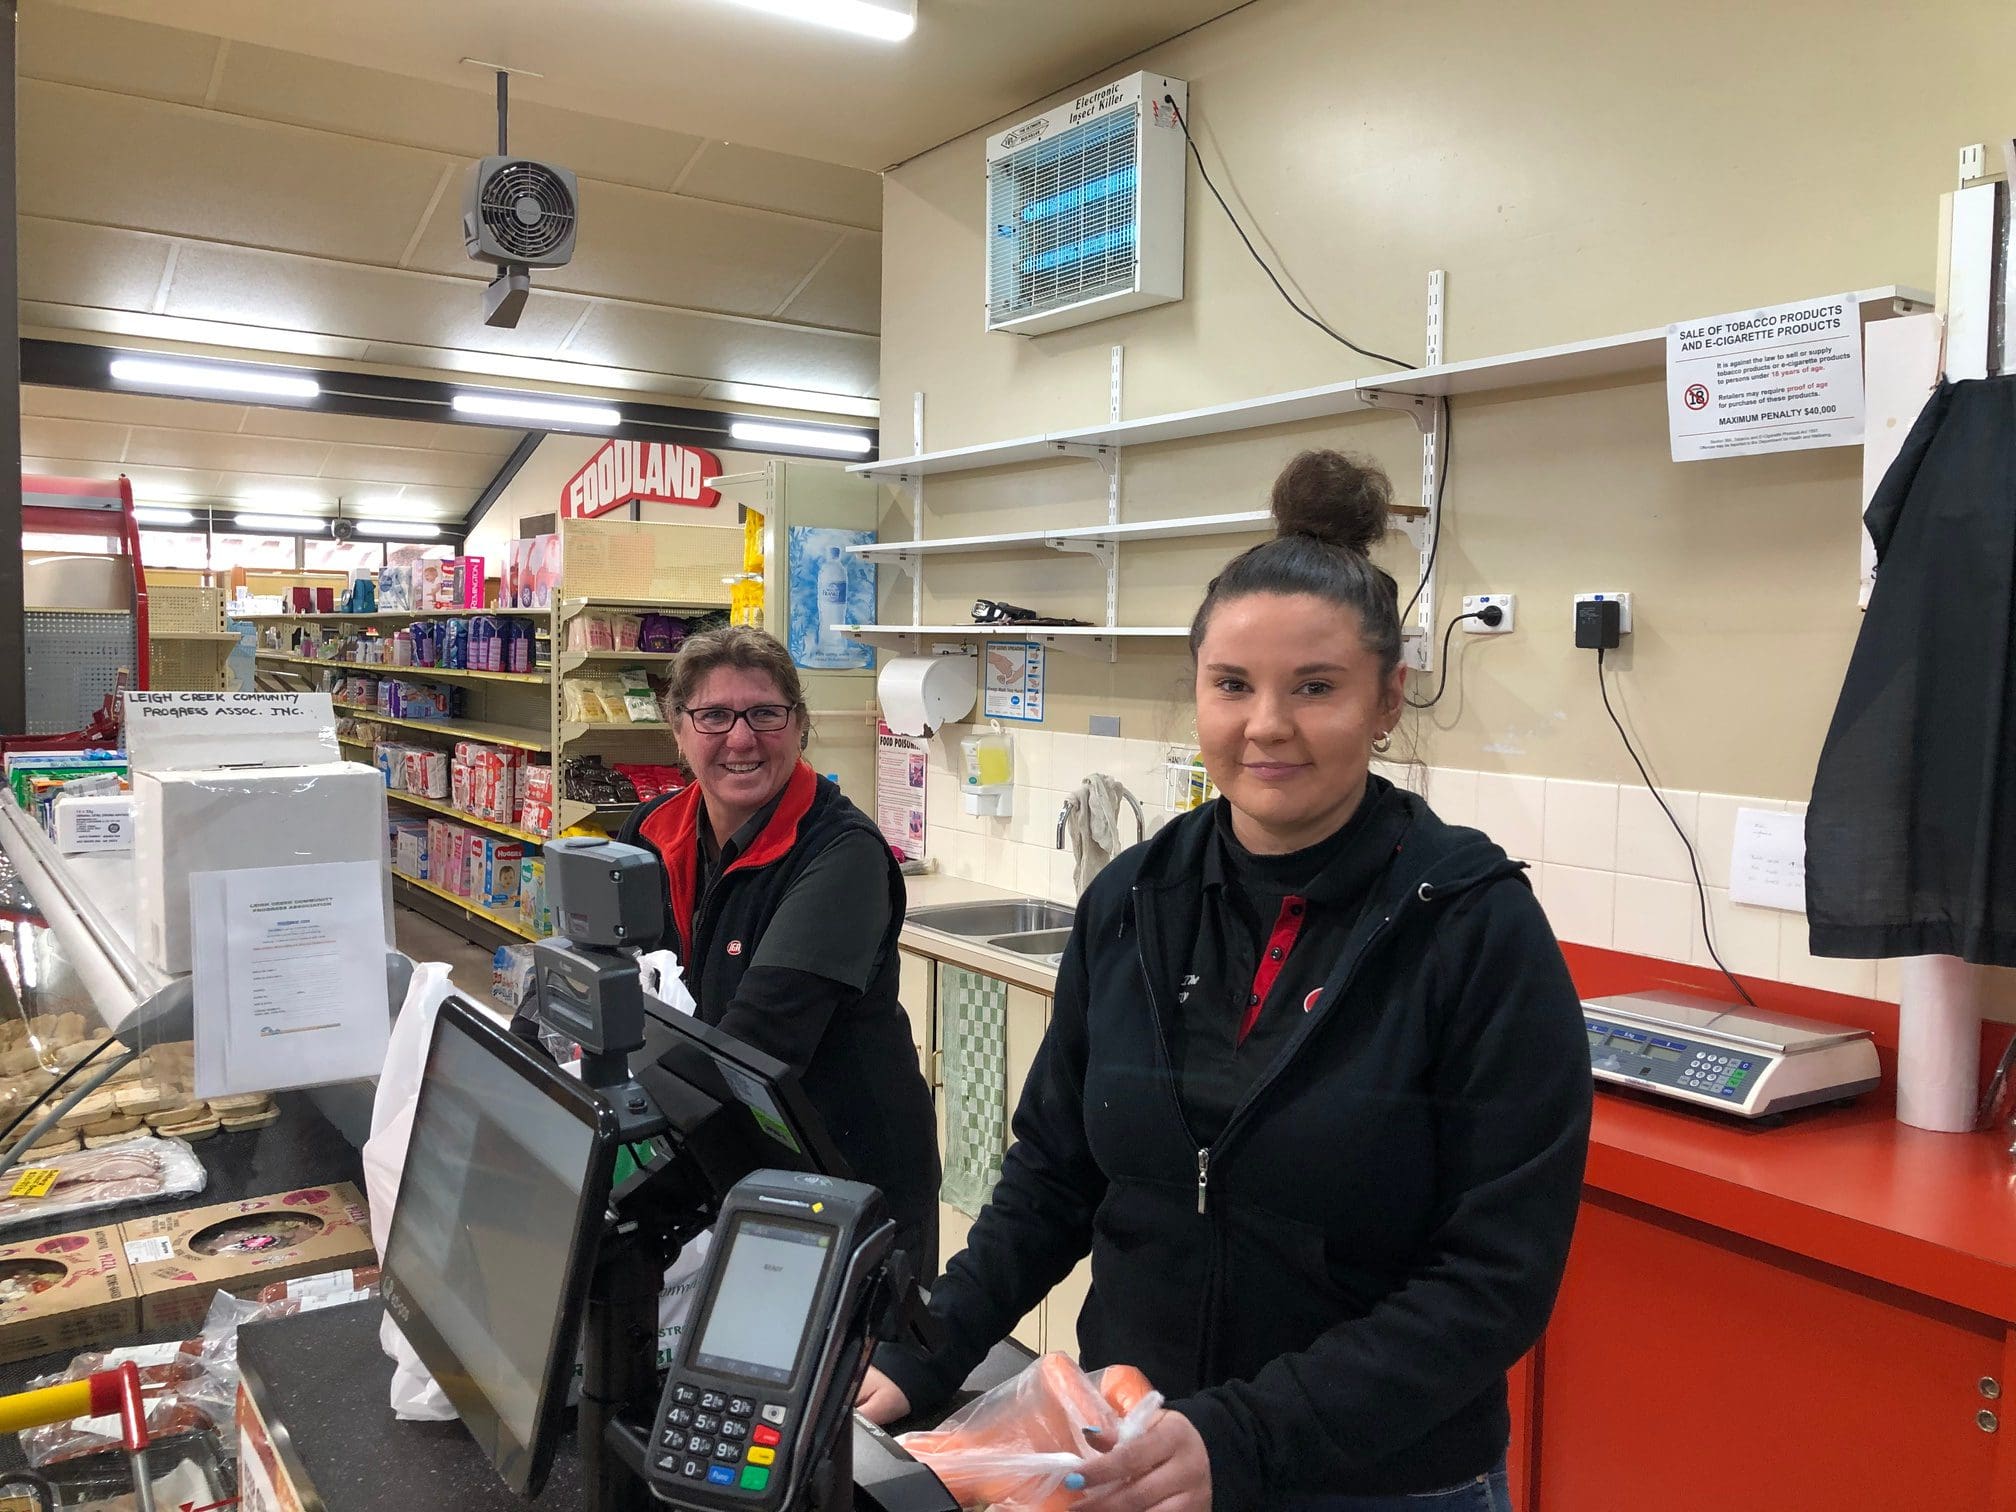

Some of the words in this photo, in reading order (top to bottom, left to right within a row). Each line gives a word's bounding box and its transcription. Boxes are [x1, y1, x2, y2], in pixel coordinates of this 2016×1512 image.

[1075, 83, 1120, 110] Electronic
[1069, 106, 1094, 124] Insect
[1098, 93, 1124, 111] Killer
[1679, 327, 1704, 341] SALE
[1707, 325, 1722, 336] OF
[1726, 316, 1777, 333] TOBACCO
[1780, 305, 1842, 324] PRODUCTS
[1681, 339, 1702, 352] AND
[1705, 329, 1774, 348] E-CIGARETTE
[1777, 318, 1841, 336] PRODUCTS
[1730, 359, 1752, 368] against
[1786, 351, 1798, 359] sell
[1809, 346, 1832, 356] supply
[1717, 368, 1741, 377] tobacco
[1743, 364, 1771, 374] products
[1781, 357, 1818, 369] e-cigarette
[1819, 353, 1851, 364] products
[1725, 376, 1750, 385] persons
[1751, 372, 1770, 381] under
[1780, 368, 1800, 377] years
[1690, 390, 1705, 405] 18
[1718, 391, 1744, 401] Retailers
[1746, 389, 1759, 398] may
[1761, 386, 1785, 397] require
[1787, 382, 1806, 393] proof
[1807, 382, 1815, 390] of
[1816, 381, 1828, 390] age
[1718, 401, 1727, 409] for
[1728, 397, 1757, 409] purchase
[1758, 396, 1766, 404] of
[1767, 394, 1786, 404] these
[1787, 391, 1820, 402] products.
[1719, 414, 1758, 425] MAXIMUM
[1760, 409, 1802, 421] PENALTY
[1804, 404, 1837, 417] $40,000
[570, 439, 701, 519] FOODLAND
[470, 564, 479, 610] REMINGTON
[128, 693, 172, 704] LEIGH
[179, 693, 225, 702] CREEK
[233, 693, 299, 704] COMMUNITY
[143, 707, 208, 718] PROGRESS
[215, 707, 262, 716] ASSOC.
[271, 707, 304, 716] INC.
[880, 736, 893, 746] FOOD
[676, 1387, 684, 1400] 1
[702, 1393, 713, 1407] 2
[730, 1399, 741, 1413] 3
[668, 1408, 679, 1421] 4
[695, 1414, 706, 1428] 5
[723, 1421, 734, 1434] 6
[663, 1430, 674, 1443] 7
[689, 1437, 700, 1451] 8
[716, 1443, 727, 1457] 9
[685, 1461, 696, 1476] 0
